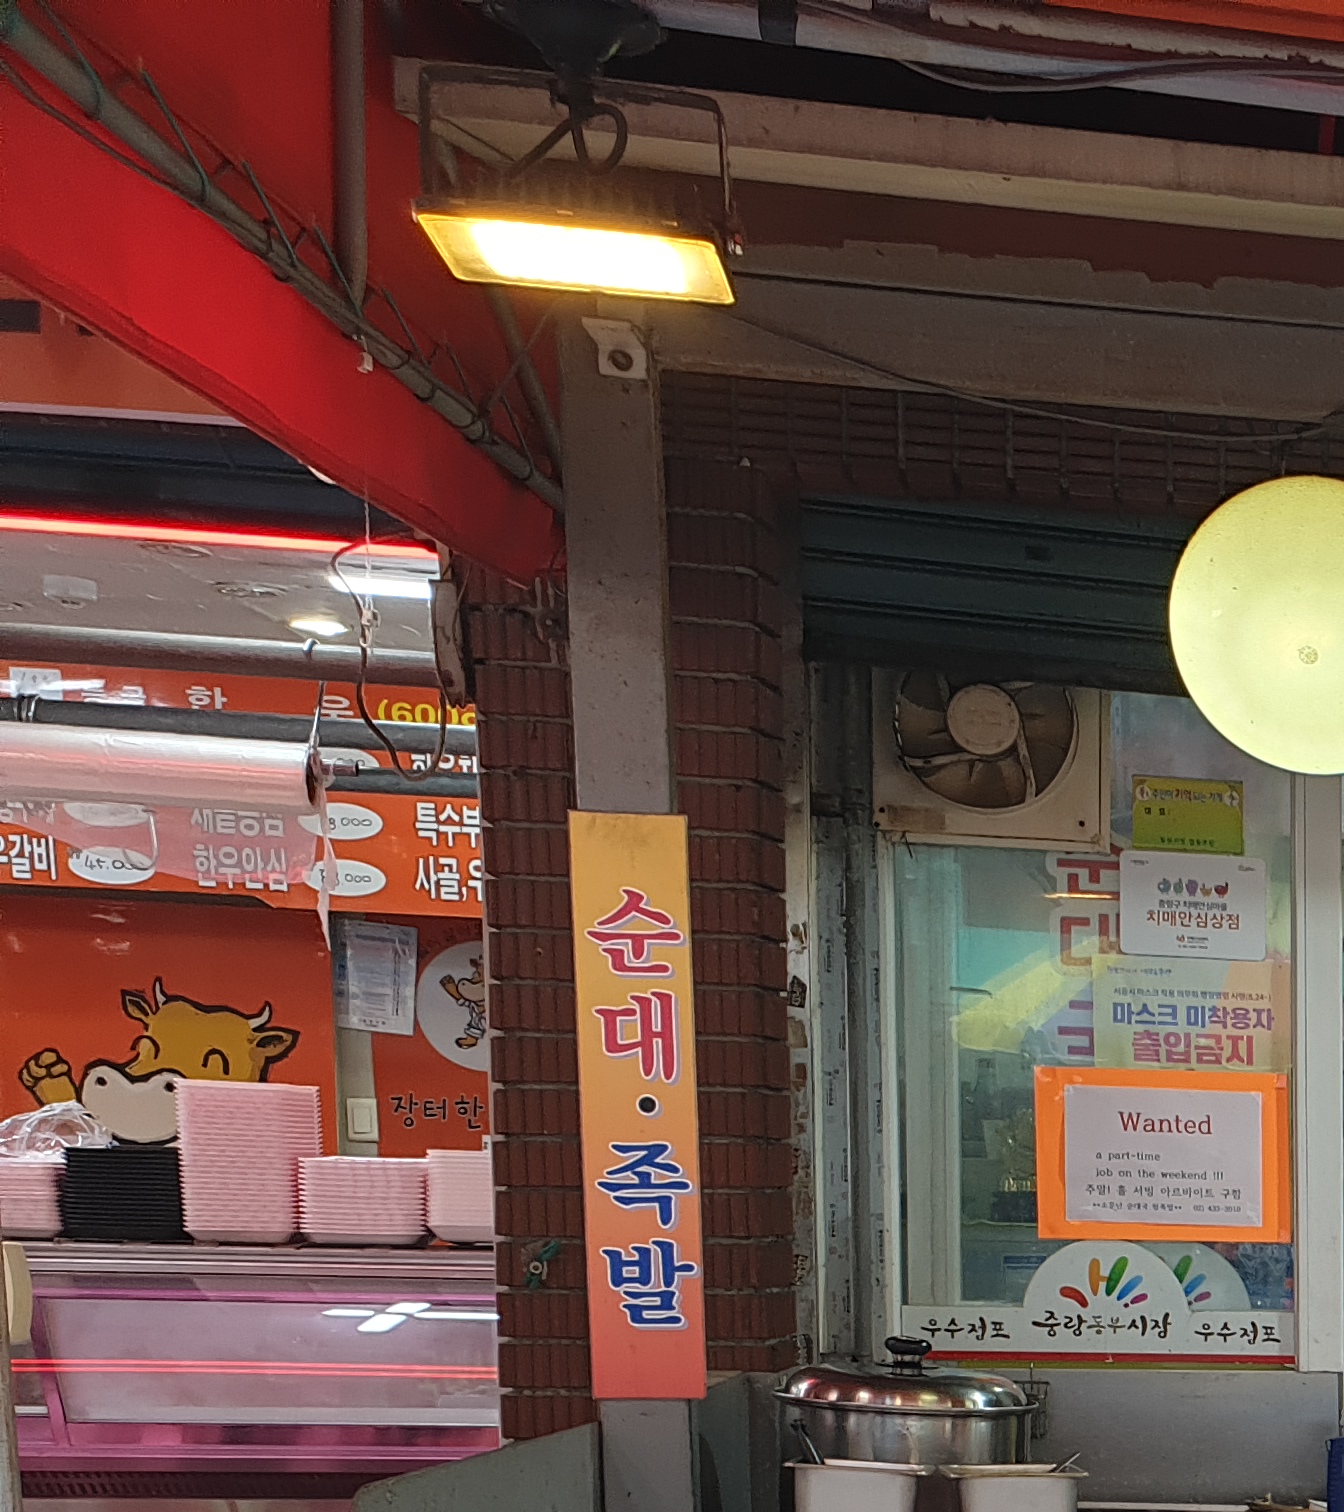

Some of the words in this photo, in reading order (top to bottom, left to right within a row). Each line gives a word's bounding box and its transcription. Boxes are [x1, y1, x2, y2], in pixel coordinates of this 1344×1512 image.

[193, 843, 289, 891] 한우안심
[1146, 909, 1240, 930] 치매안심상점
[1112, 1002, 1179, 1027] 마스크
[1186, 1004, 1275, 1031] 미착용자
[1132, 1030, 1255, 1067] 출입금지
[1118, 1110, 1213, 1135] Wanted
[1095, 1152, 1102, 1160] a
[1108, 1151, 1161, 1163] part-time
[1095, 1168, 1113, 1179] job
[1118, 1170, 1132, 1178] on
[1137, 1168, 1155, 1179] the
[1161, 1170, 1207, 1181] weekend
[1160, 1186, 1215, 1199] 아르바이트
[921, 1316, 1010, 1341] 우수점포
[1032, 1310, 1172, 1337] 중랑동부시장
[1195, 1320, 1281, 1345] 우수점포
